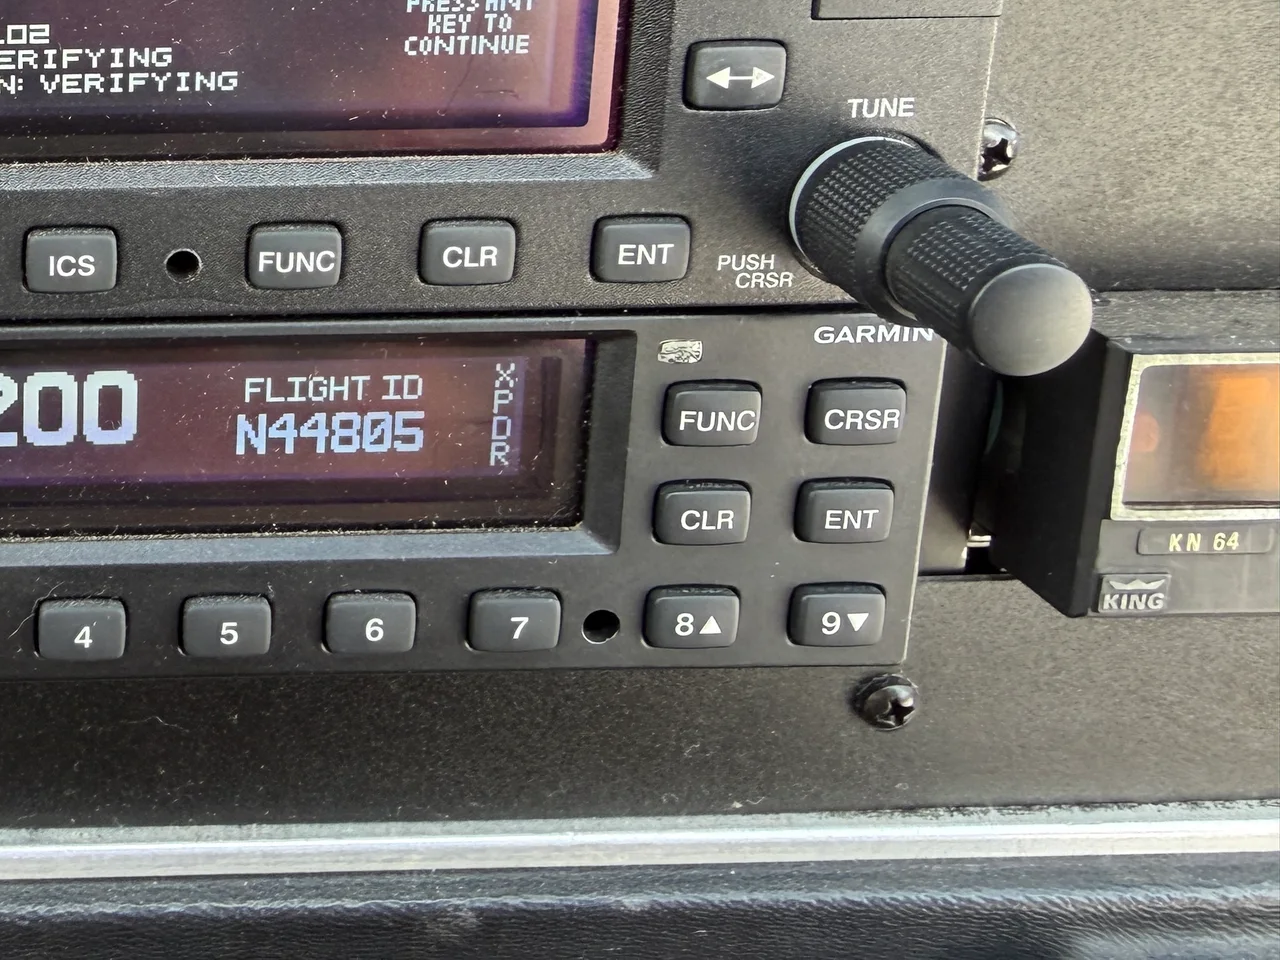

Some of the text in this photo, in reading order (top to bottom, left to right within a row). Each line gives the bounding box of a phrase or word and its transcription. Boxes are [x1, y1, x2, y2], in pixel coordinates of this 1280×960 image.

[427, 13, 512, 34] KEY TO
[404, 35, 530, 56] CONTINUE
[39, 71, 239, 94] VERIFYING
[847, 97, 915, 118] TUNE
[49, 254, 95, 277] ICS
[257, 251, 336, 273] FUNC
[442, 246, 498, 268] CLR
[617, 244, 675, 265] ENT
[717, 254, 775, 272] PUSH
[735, 272, 793, 289] CRSR
[813, 325, 935, 344] GARMIN
[244, 374, 423, 403] FLIGHT ID
[679, 410, 756, 431] FUNC
[824, 408, 901, 430] CRSR
[235, 411, 425, 455] N44805
[680, 510, 735, 531] CLR
[825, 509, 880, 530] ENT
[1169, 532, 1240, 552] KN 64
[1103, 593, 1165, 610] KING
[220, 622, 239, 645] 5
[365, 618, 384, 642] 6
[510, 617, 529, 640] 7
[674, 613, 694, 636] 8
[821, 611, 841, 635] 9
[74, 625, 93, 648] 4
